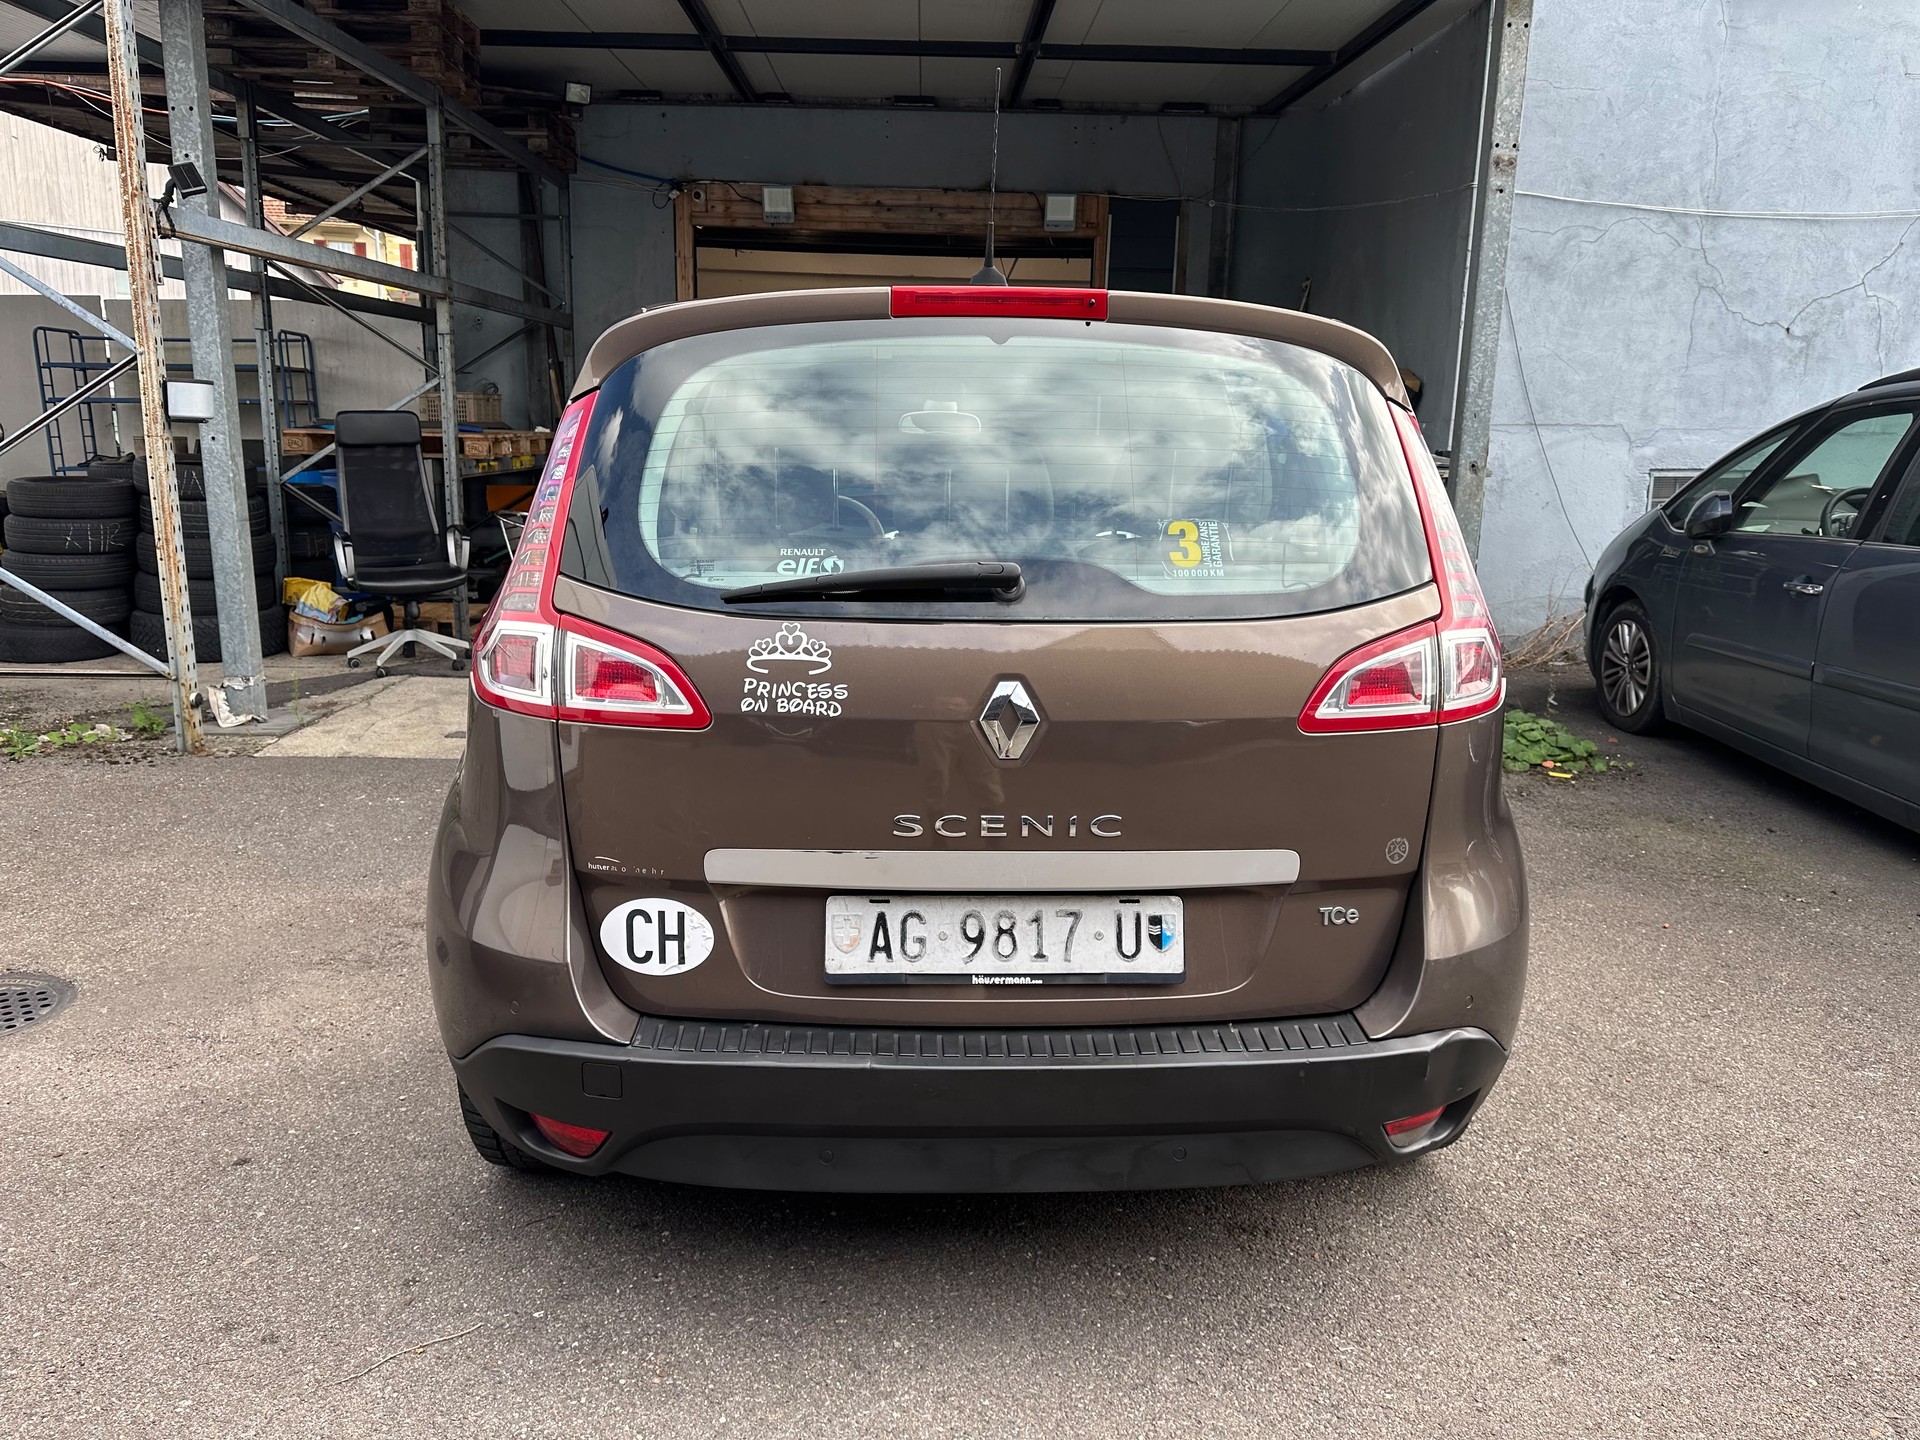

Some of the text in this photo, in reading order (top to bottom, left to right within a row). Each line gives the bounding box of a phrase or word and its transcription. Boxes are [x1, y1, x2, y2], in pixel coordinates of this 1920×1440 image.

[780, 548, 826, 556] RENAULT
[1167, 521, 1202, 568] 3
[1199, 521, 1212, 568] JAHRE/ANS
[1208, 520, 1223, 568] GARANTIE
[776, 558, 819, 576] elf
[1210, 569, 1224, 577] KM
[743, 677, 849, 700] PRINCESS
[740, 698, 842, 718] ON BOARD
[892, 814, 1123, 838] SCENIC
[1319, 906, 1360, 926] TCe
[625, 908, 686, 966] CH
[867, 909, 1142, 965] AG 9817 U
